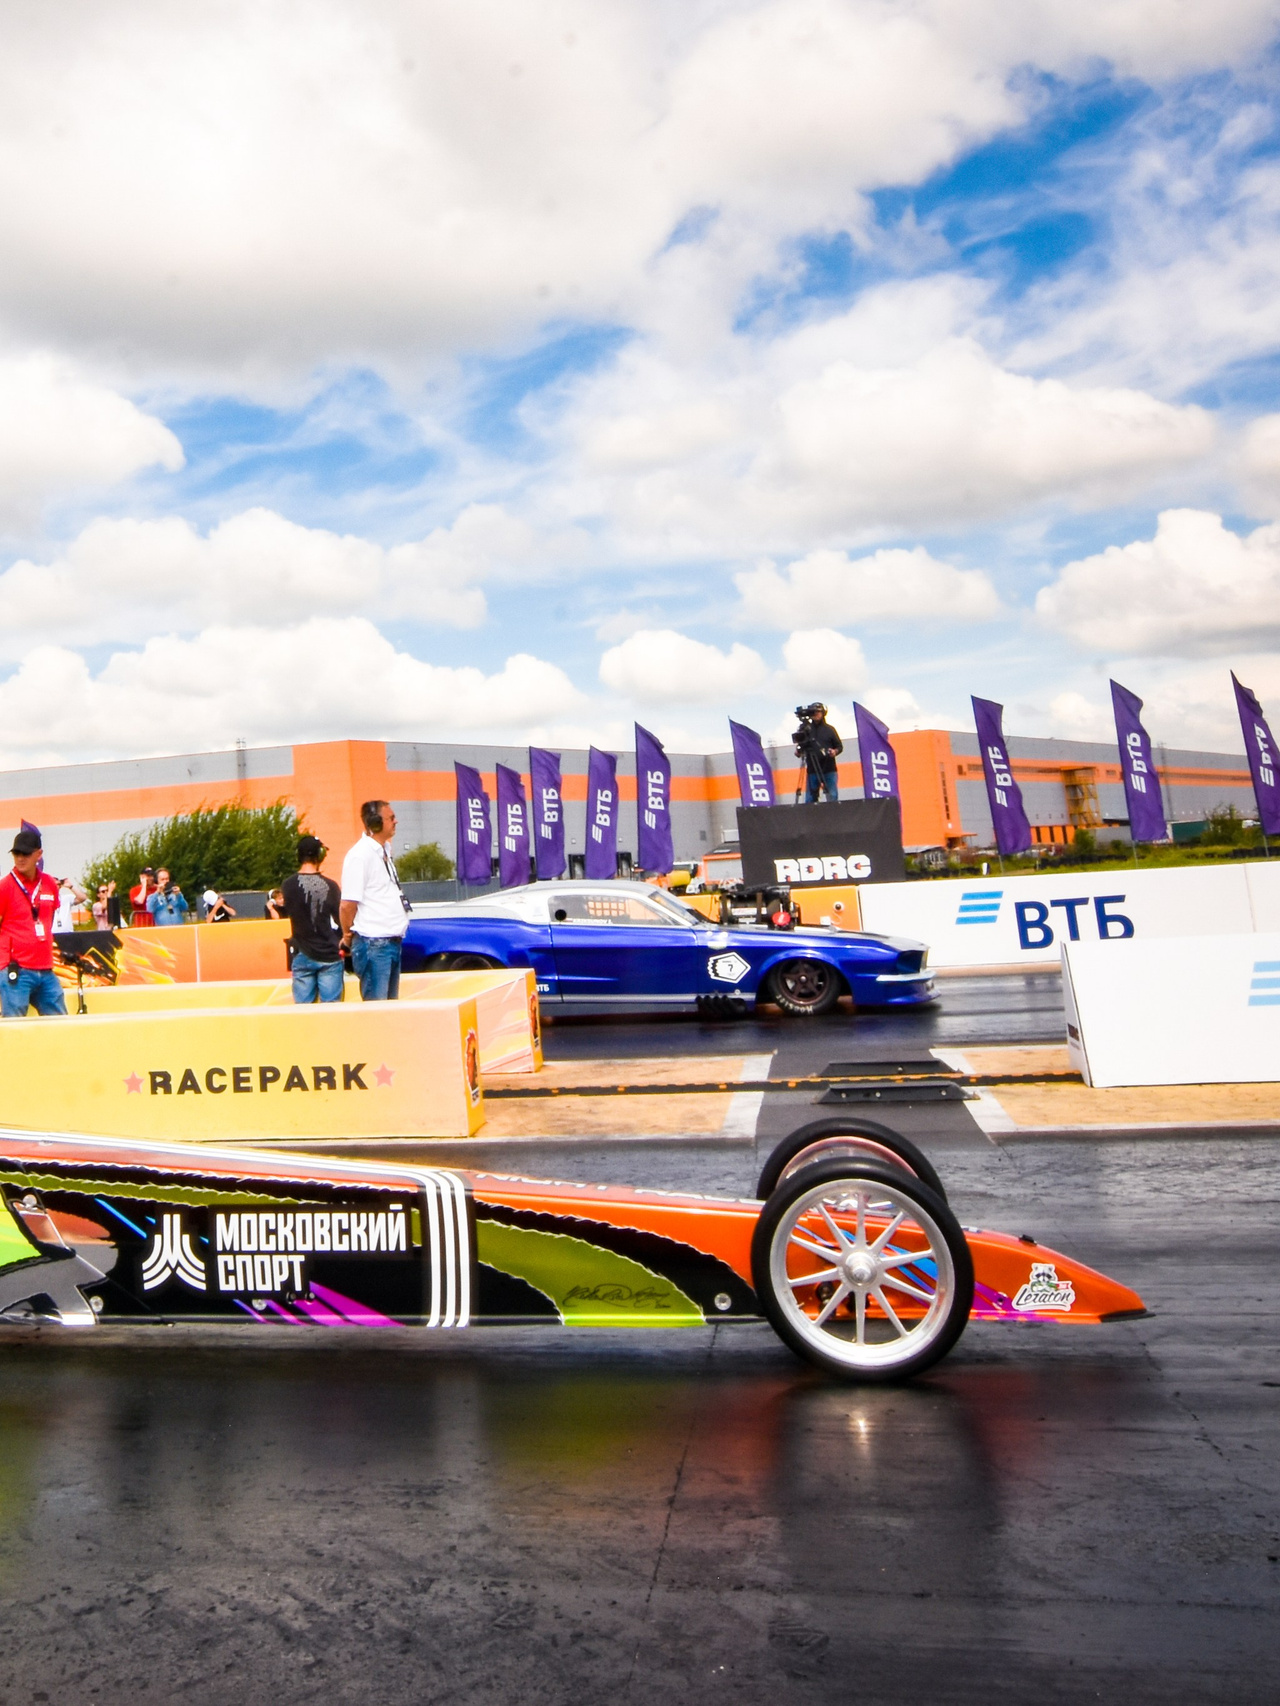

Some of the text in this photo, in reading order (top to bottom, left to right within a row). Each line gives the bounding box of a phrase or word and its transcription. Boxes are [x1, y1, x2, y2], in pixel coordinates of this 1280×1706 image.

[746, 762, 770, 802] ВТБ
[871, 751, 892, 792] ВТБ
[988, 746, 1012, 787] ВТБ
[542, 788, 559, 823] ВТБ
[596, 789, 613, 827] ВТБ
[647, 770, 665, 811] ВТБ
[468, 798, 485, 829] ВТБ
[507, 803, 523, 836] ВТБ
[774, 854, 871, 883] RDRC
[1014, 895, 1135, 950] ВТБ
[727, 964, 734, 972] 7
[149, 1063, 369, 1095] RACEPARK
[215, 1203, 407, 1252] МОСКОВСКИЙ
[217, 1254, 306, 1292] СПОРТ
